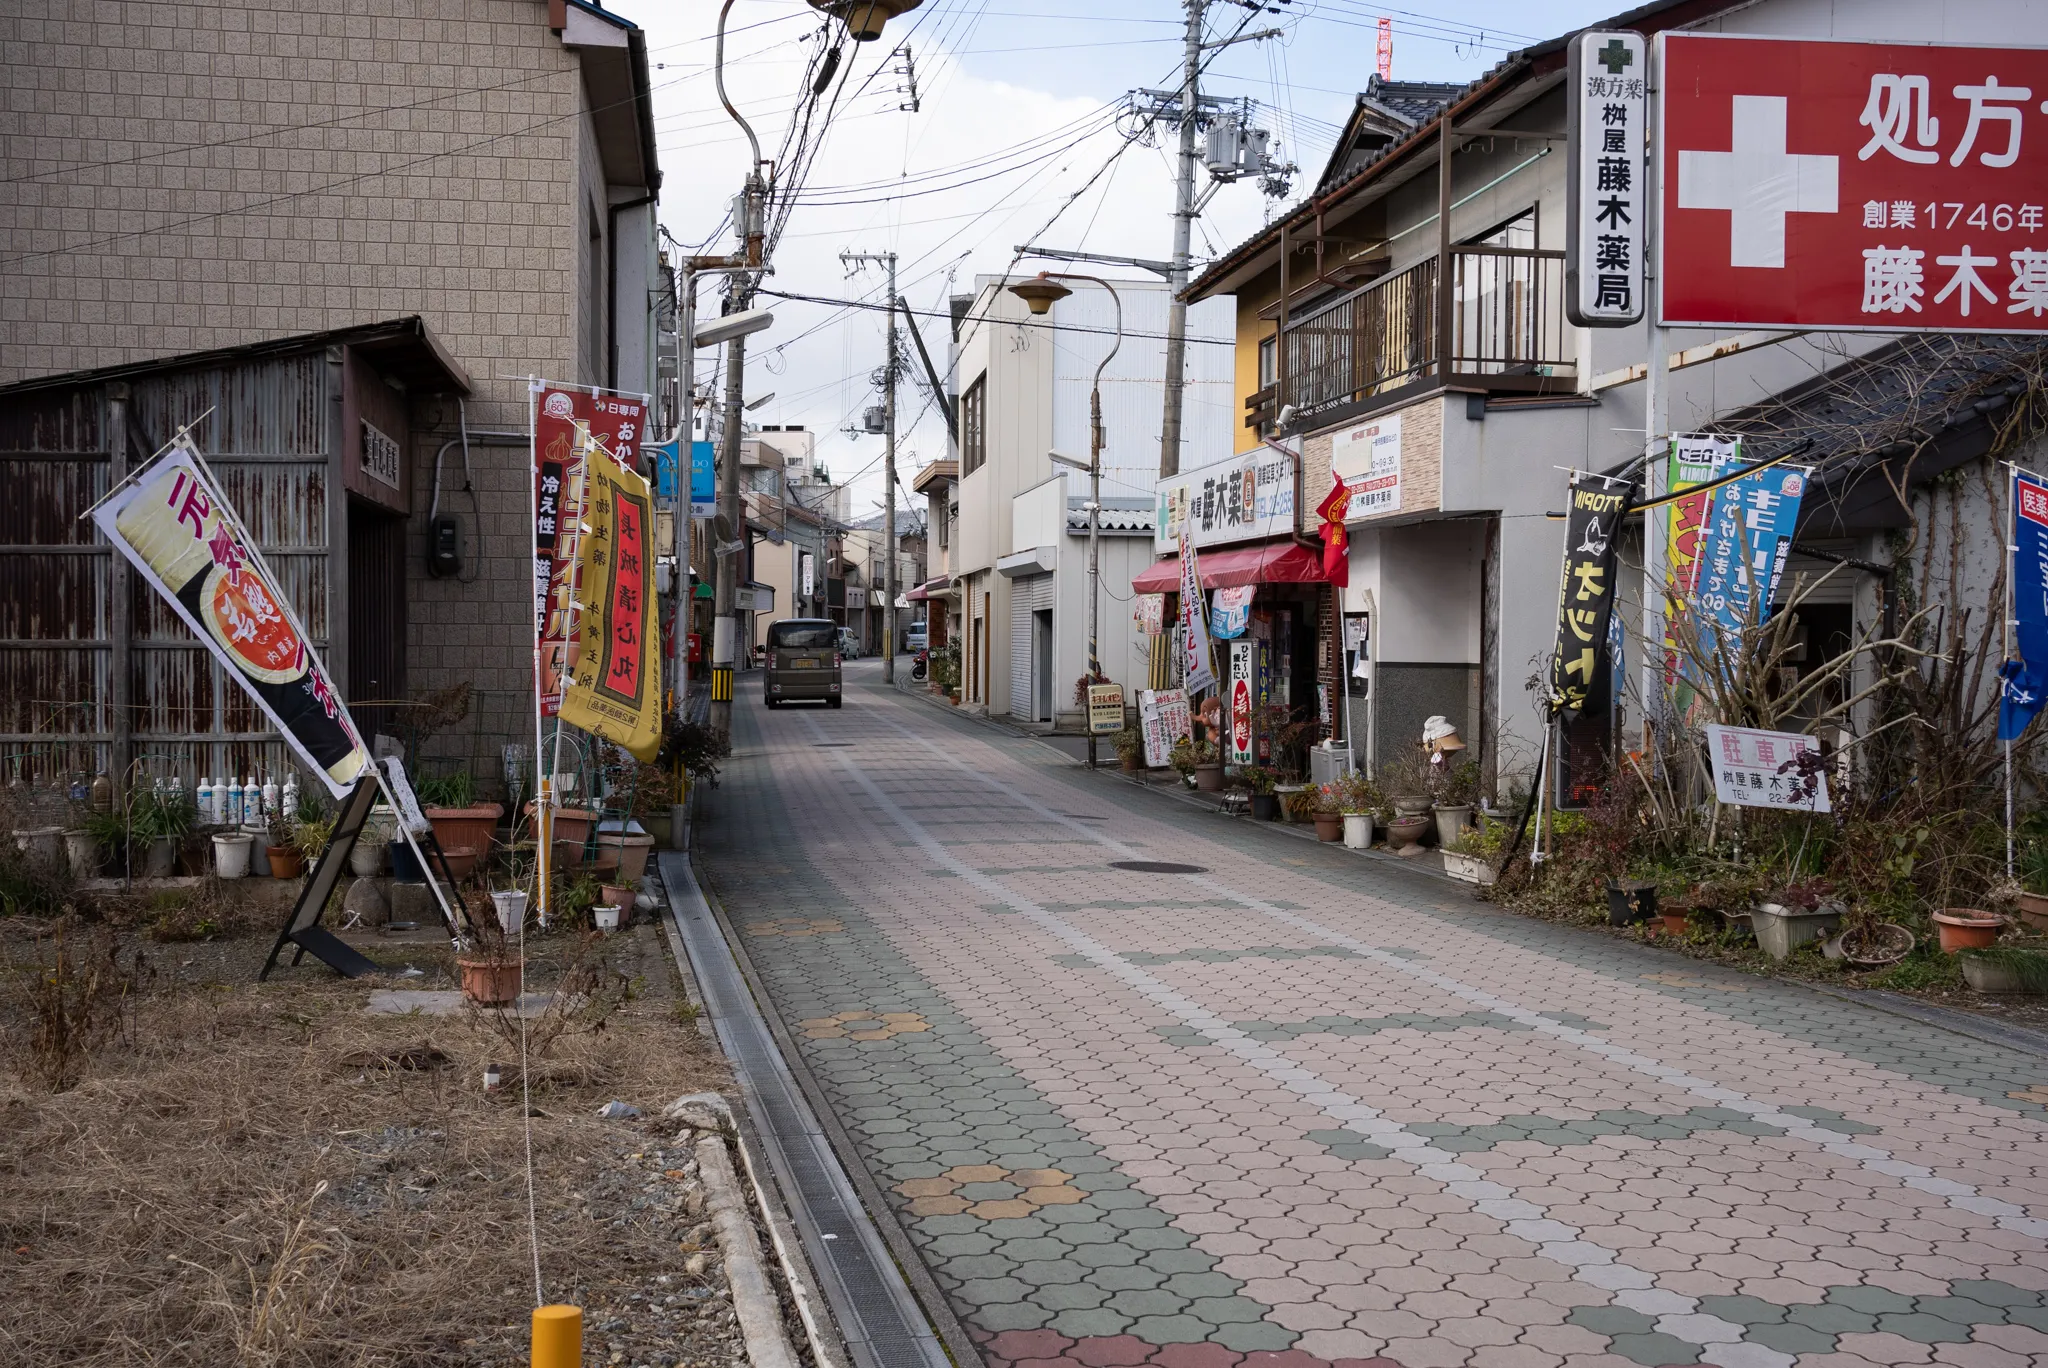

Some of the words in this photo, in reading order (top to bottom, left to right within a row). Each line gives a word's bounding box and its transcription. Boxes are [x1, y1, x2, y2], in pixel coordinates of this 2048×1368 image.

[1587, 76, 1644, 100] 漢方薬
[1858, 74, 2048, 168] 処方
[1862, 199, 2044, 233] 創業1746年
[608, 402, 639, 417] 日専同
[614, 421, 636, 471] おか
[537, 475, 560, 536] 冷え性
[1233, 653, 1241, 680] 疲れに
